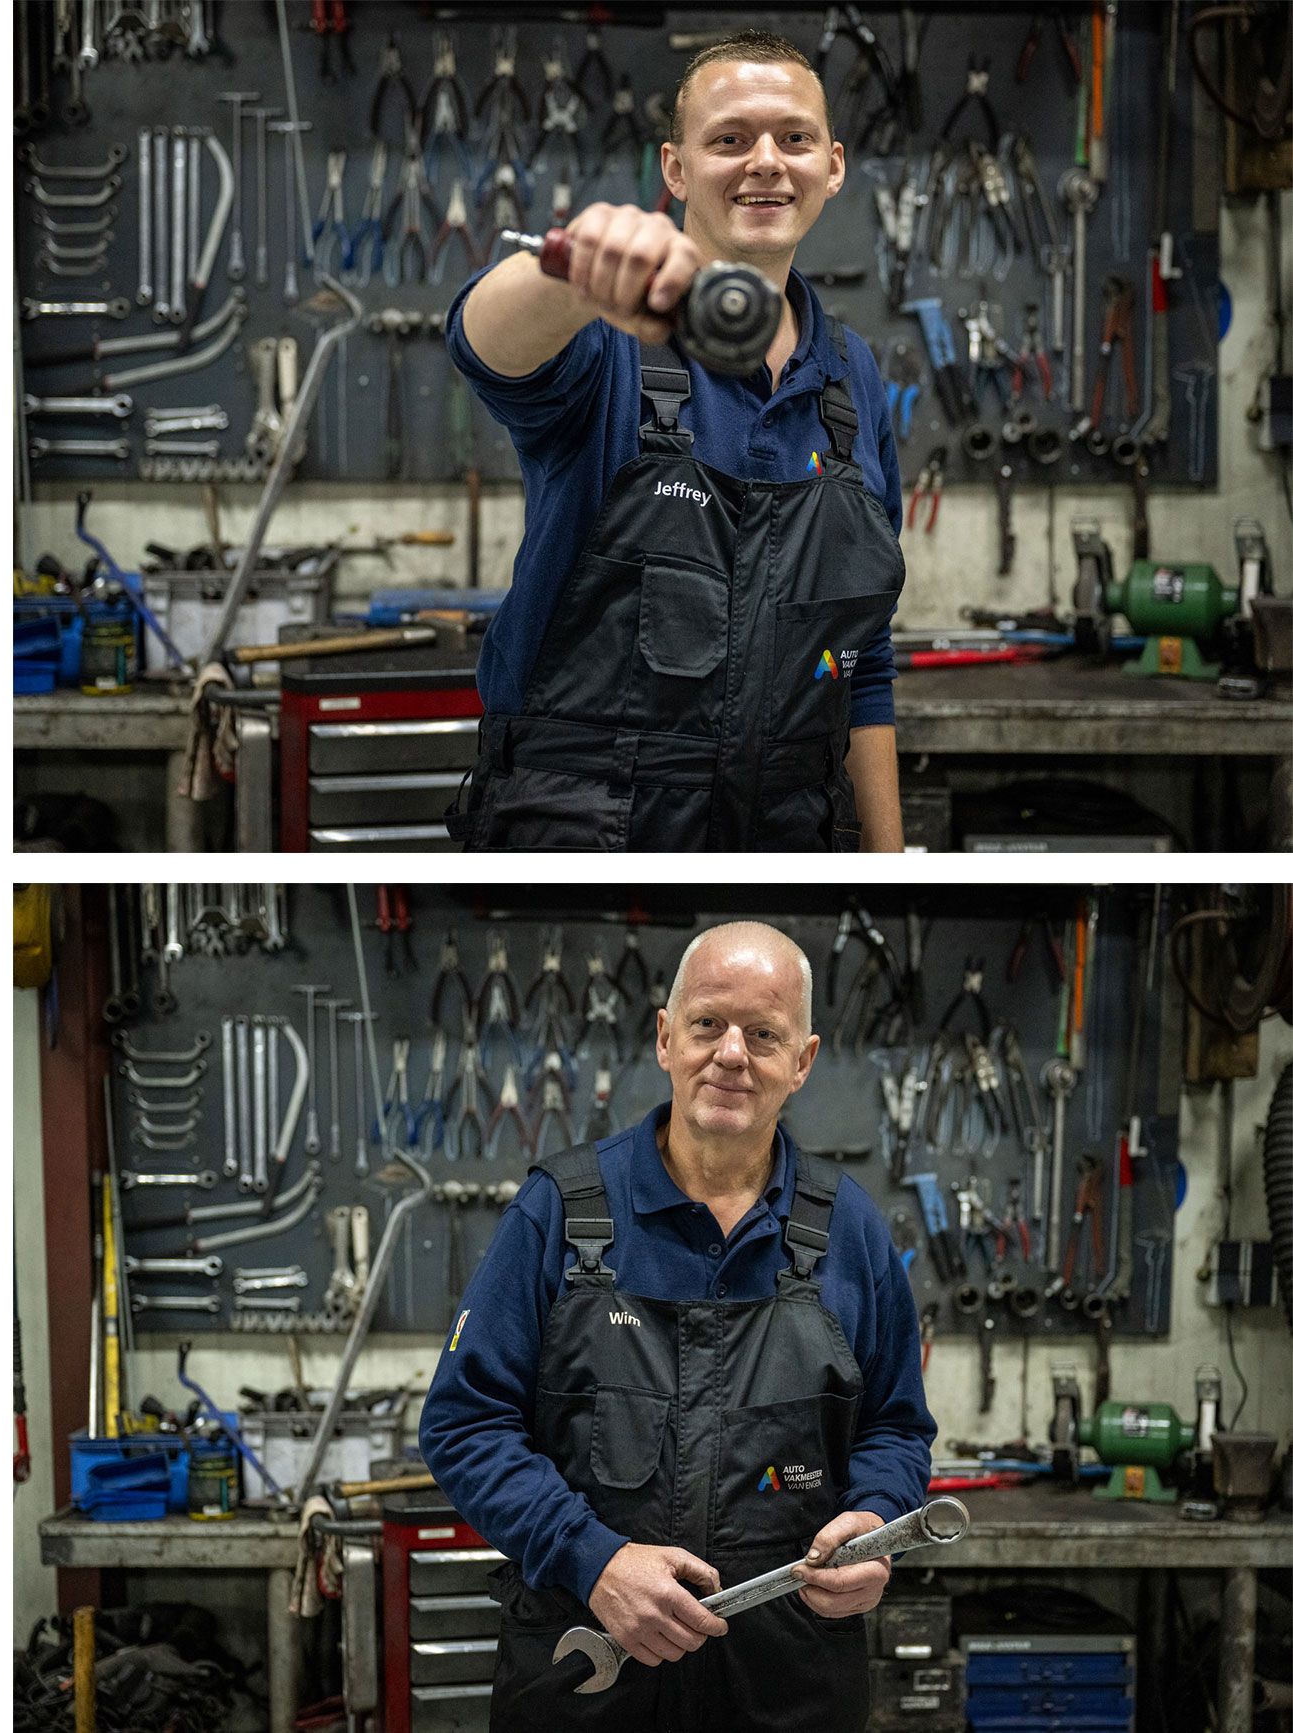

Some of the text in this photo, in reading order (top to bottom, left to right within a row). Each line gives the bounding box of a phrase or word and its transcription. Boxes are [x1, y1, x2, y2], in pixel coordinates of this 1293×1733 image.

[654, 481, 712, 507] Jeffrey
[608, 1311, 641, 1327] Wim
[783, 1465, 805, 1474] AUTO
